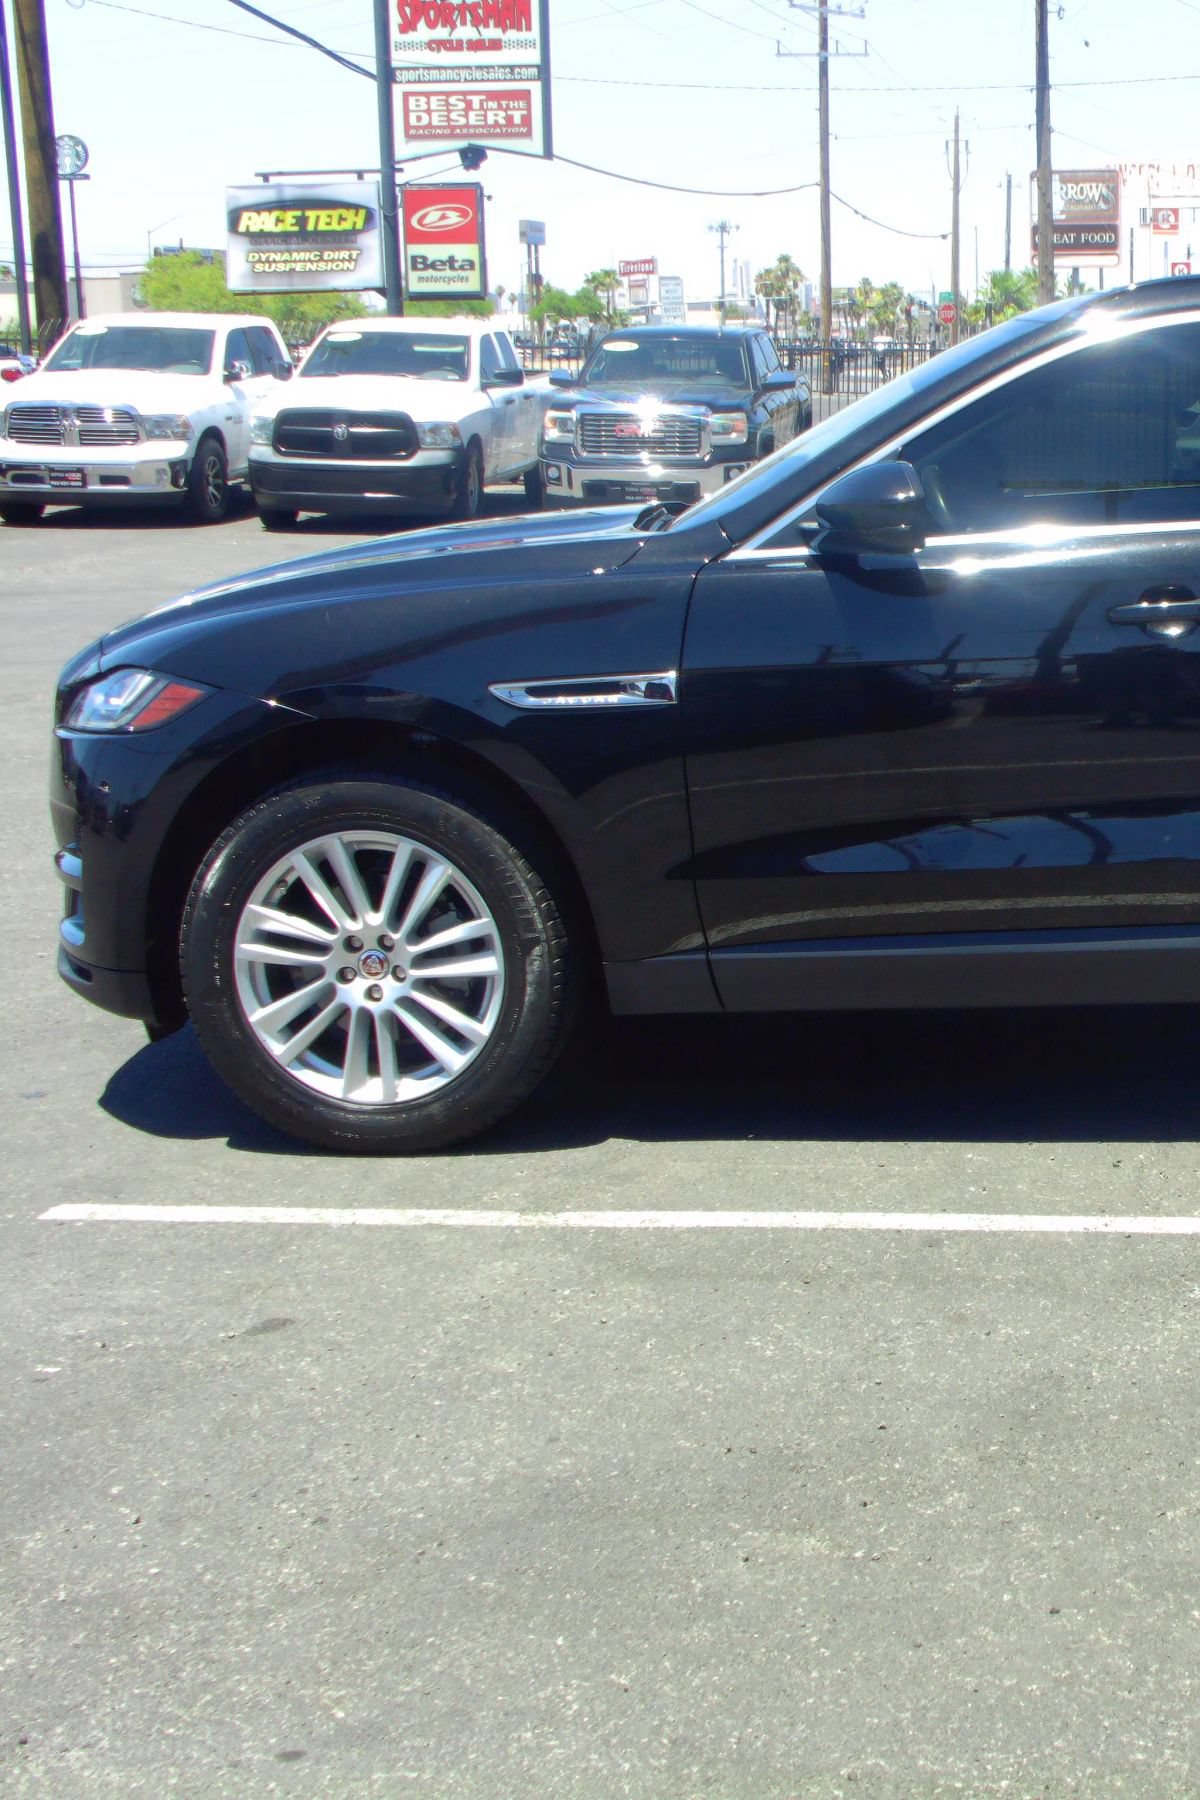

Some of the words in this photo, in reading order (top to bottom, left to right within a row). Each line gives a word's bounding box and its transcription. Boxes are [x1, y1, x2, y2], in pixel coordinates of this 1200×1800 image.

[396, 0, 532, 35] SPORTSMAN
[395, 66, 539, 83] sportsmancyclesales.com
[408, 95, 486, 111] BEST
[483, 101, 498, 110] IN
[499, 100, 528, 109] THE
[408, 110, 528, 127] DESERT
[409, 127, 450, 136] RACING
[454, 127, 528, 135] ASSOCIATION
[1060, 183, 1115, 210] RROWS
[237, 210, 302, 233] RACE
[305, 208, 368, 232] TECH
[1081, 232, 1115, 244] FOOD
[248, 251, 322, 263] DYNAMIC
[323, 250, 361, 261] DIRT
[410, 255, 476, 272] Beta
[252, 261, 356, 273] SUSPENSION
[417, 275, 470, 285] motorcycles
[940, 309, 955, 319] STOP
